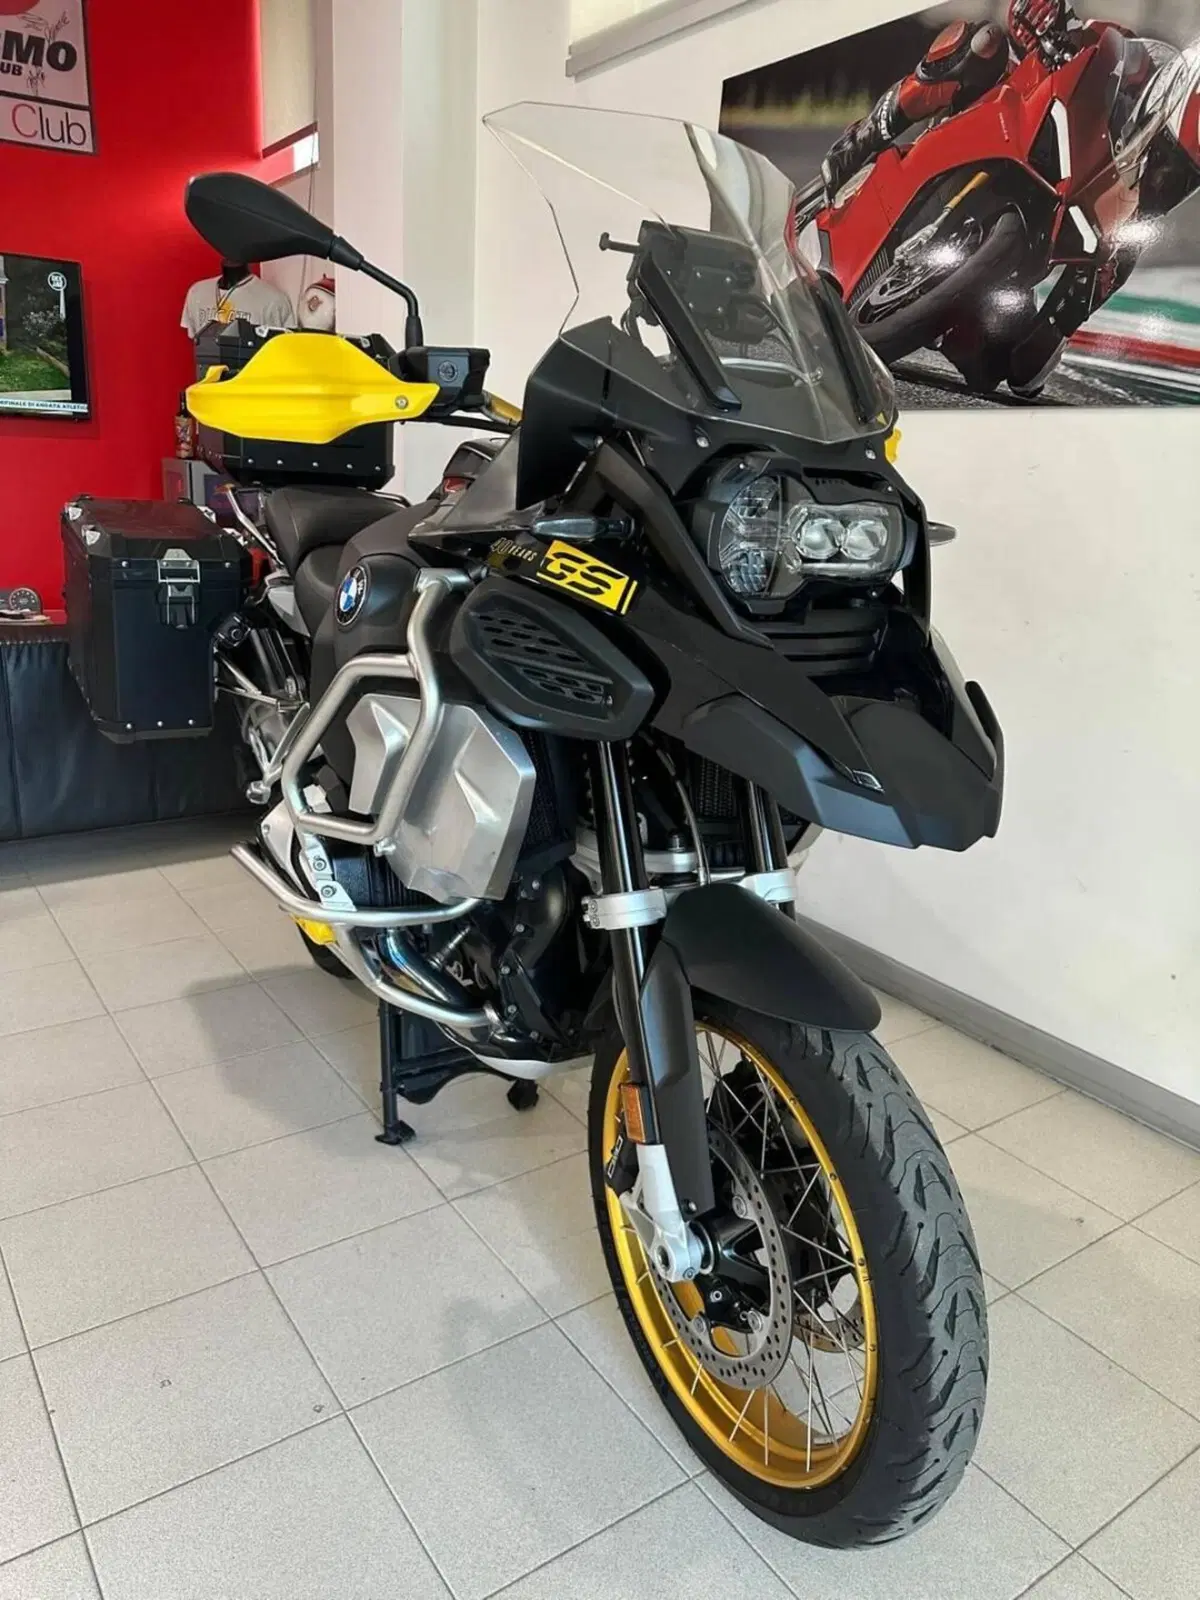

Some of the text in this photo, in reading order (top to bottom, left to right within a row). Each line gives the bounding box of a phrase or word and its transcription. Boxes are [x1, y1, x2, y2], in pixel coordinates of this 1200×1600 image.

[0, 30, 77, 72] MO
[12, 104, 86, 146] Club
[508, 545, 538, 562] YEARS
[539, 552, 625, 596] GS
